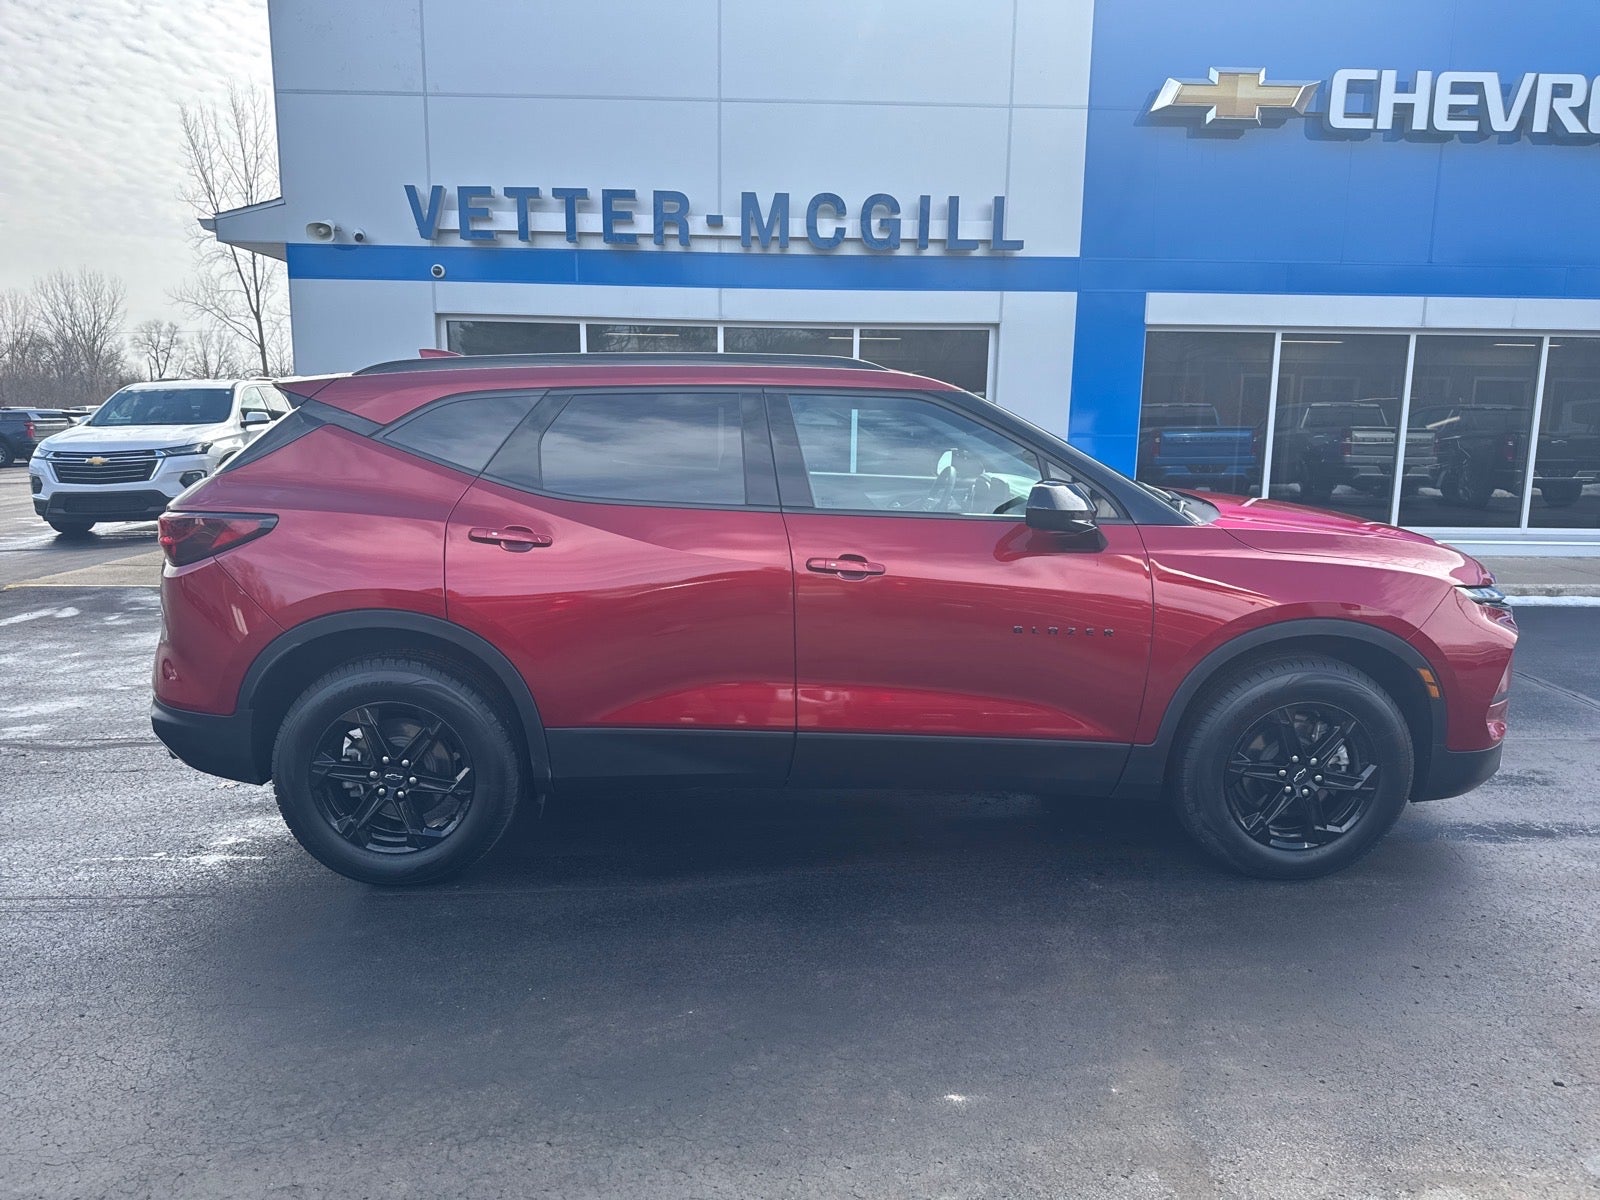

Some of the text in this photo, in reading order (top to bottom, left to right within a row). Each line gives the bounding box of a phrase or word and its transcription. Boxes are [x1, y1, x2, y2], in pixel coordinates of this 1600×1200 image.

[1329, 68, 1600, 135] CHEVR
[404, 185, 1024, 250] VETTER-MCGILL
[1013, 625, 1115, 637] BLAZER
